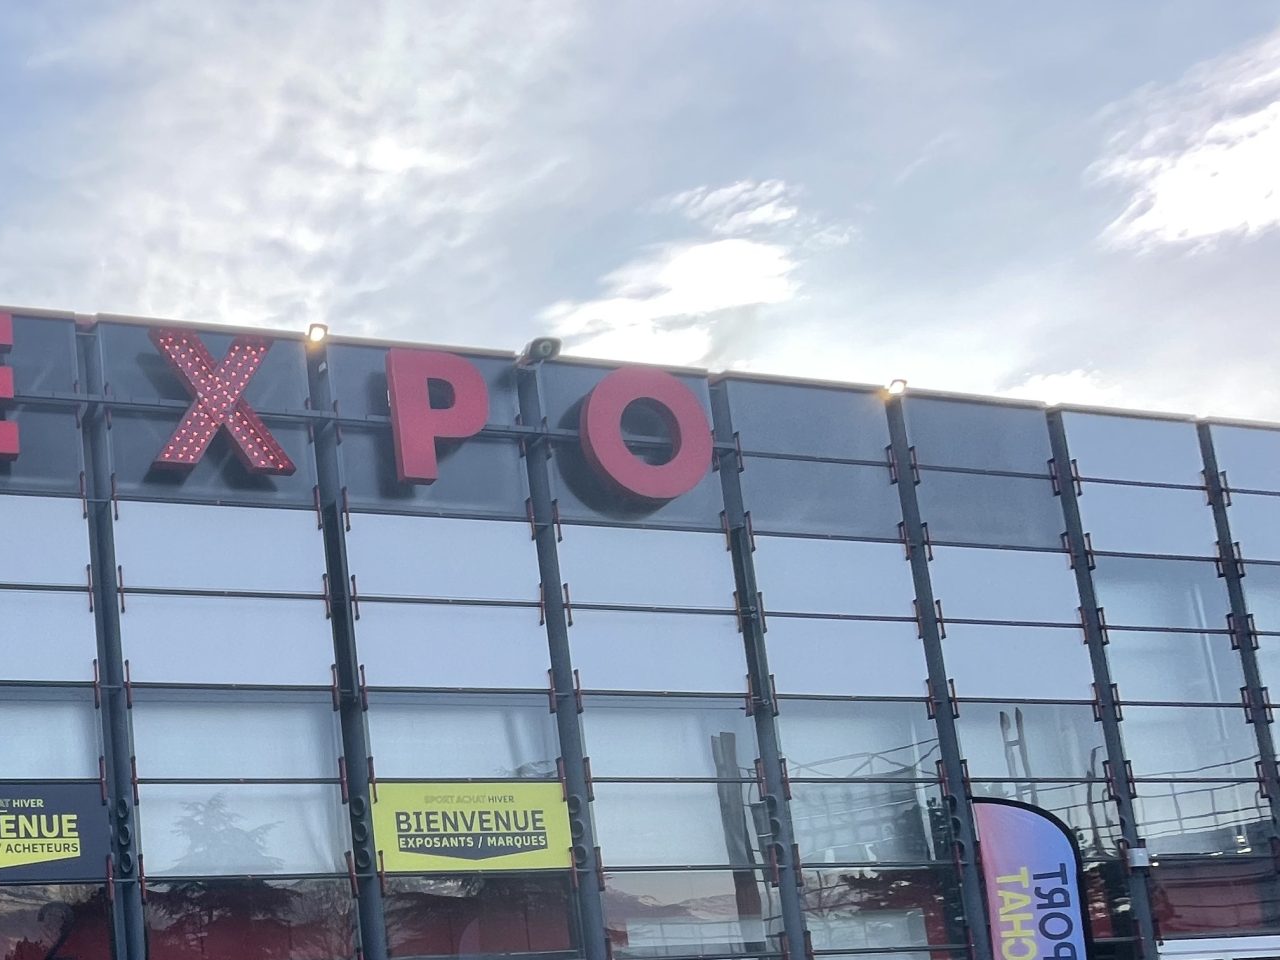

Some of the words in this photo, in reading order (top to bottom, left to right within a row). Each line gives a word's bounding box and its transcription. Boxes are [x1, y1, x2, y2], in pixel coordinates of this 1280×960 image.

[12, 798, 44, 808] HIVER
[488, 795, 514, 804] HIVER
[395, 810, 546, 833] BIENVENUE
[5, 842, 79, 854] ACHETEURS
[399, 836, 474, 849] EXPOSANTS
[487, 835, 546, 849] MARQUES
